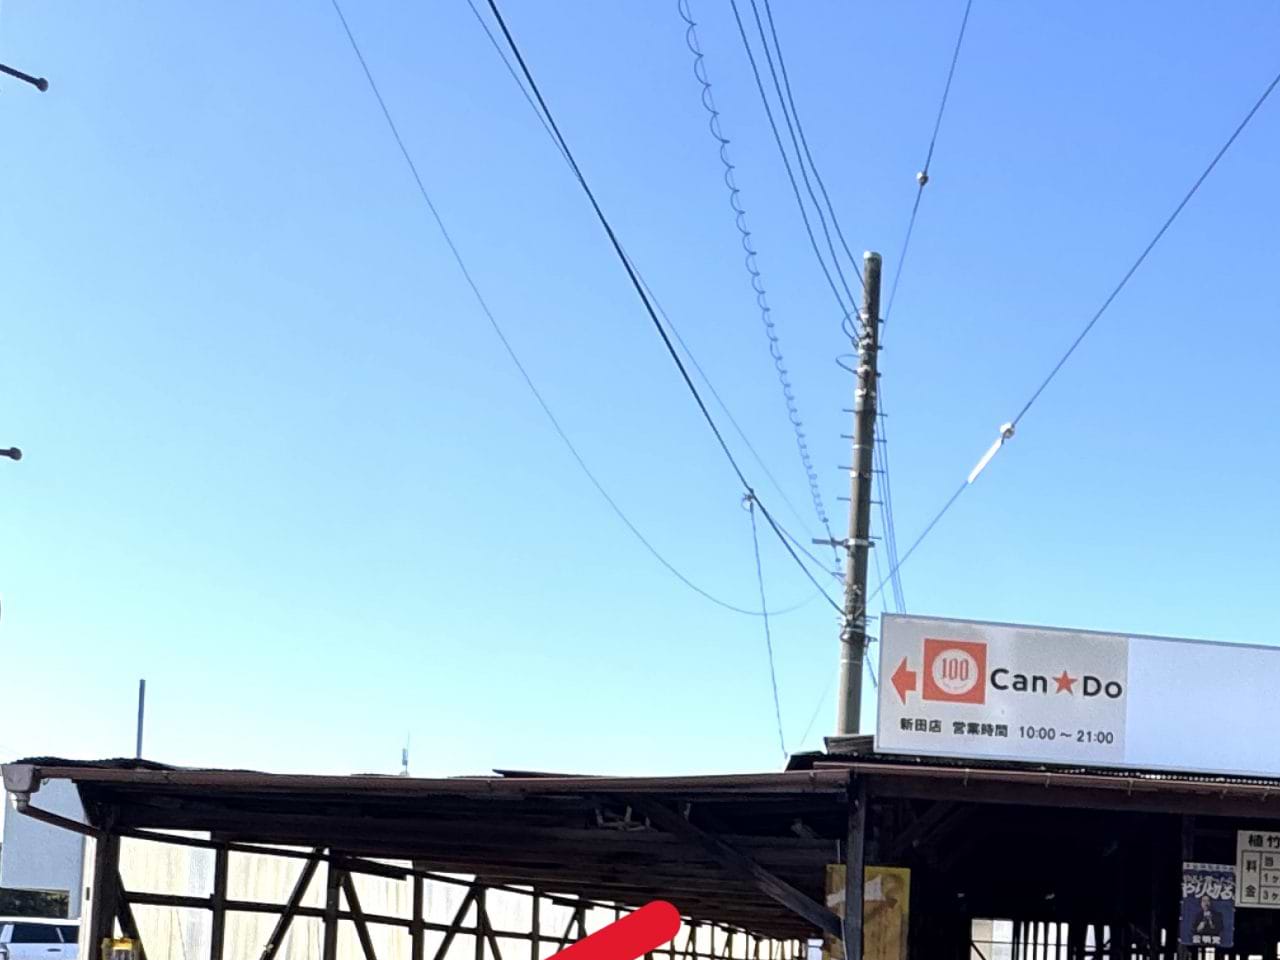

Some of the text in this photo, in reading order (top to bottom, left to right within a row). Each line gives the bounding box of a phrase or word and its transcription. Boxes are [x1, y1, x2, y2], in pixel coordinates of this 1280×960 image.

[942, 658, 969, 682] 100
[900, 717, 942, 733] 新田店
[952, 721, 1008, 738] 営業時間
